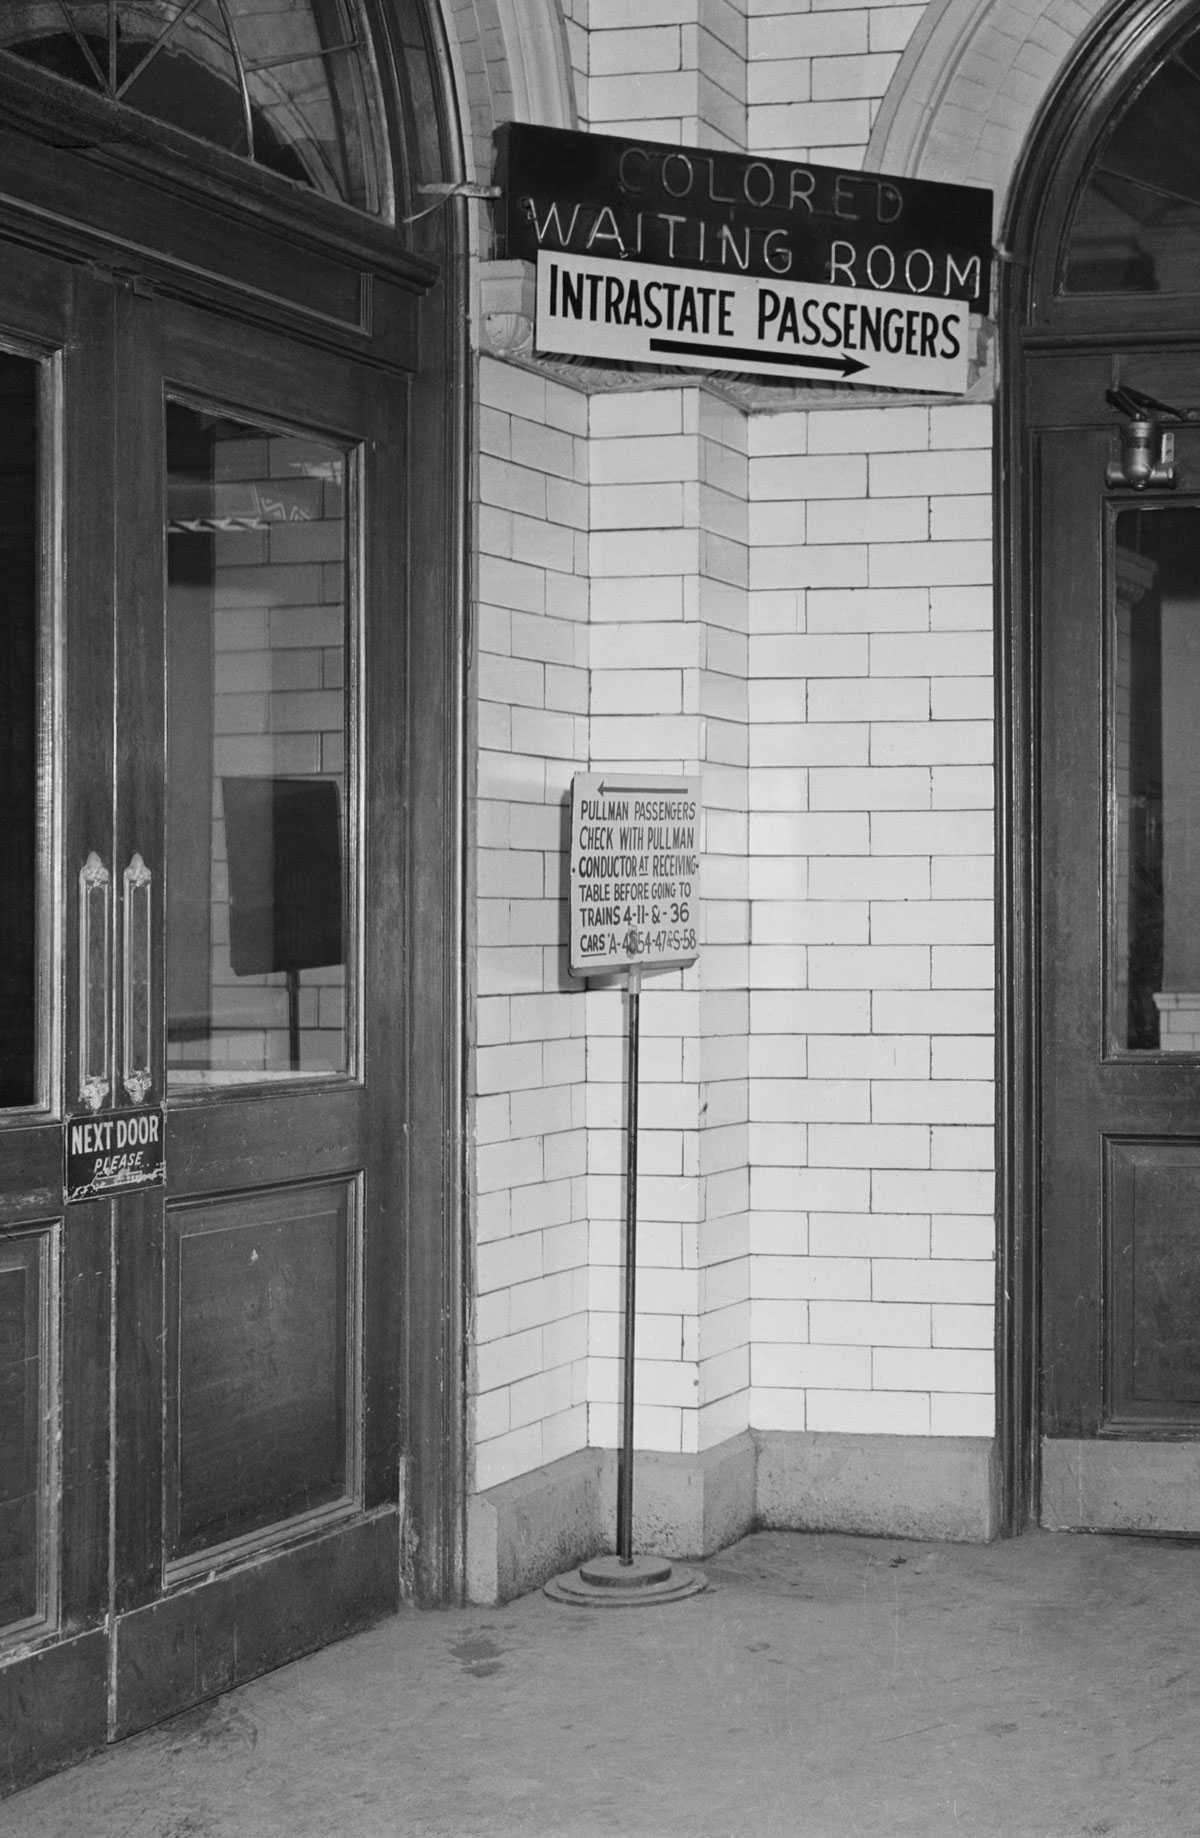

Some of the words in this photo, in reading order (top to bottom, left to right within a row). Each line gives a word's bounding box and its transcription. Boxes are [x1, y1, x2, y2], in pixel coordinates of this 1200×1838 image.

[618, 147, 904, 224] COLORED
[528, 198, 793, 274] WAITING
[829, 240, 983, 299] ROOM
[548, 263, 736, 338] INTRASTATE
[756, 288, 961, 361] PASSENGERS
[580, 799, 629, 821] PULLMAN
[633, 800, 697, 821] PASSENGERS
[579, 825, 614, 851] CHECK
[618, 826, 645, 851] WITH
[646, 826, 695, 851] PULLMAN
[578, 855, 638, 879] CONDUCTOR
[638, 855, 650, 872] AT
[651, 854, 697, 877] RECEIVING
[578, 883, 611, 903] TABLE
[614, 882, 650, 902] BEFORE
[651, 882, 677, 900] GOING
[679, 881, 692, 898] TO
[578, 905, 621, 928] TRAINS
[579, 933, 606, 953] CARS
[71, 1121, 114, 1156] NEXT
[116, 1115, 159, 1149] DOOR
[93, 1151, 144, 1174] PLEASE
